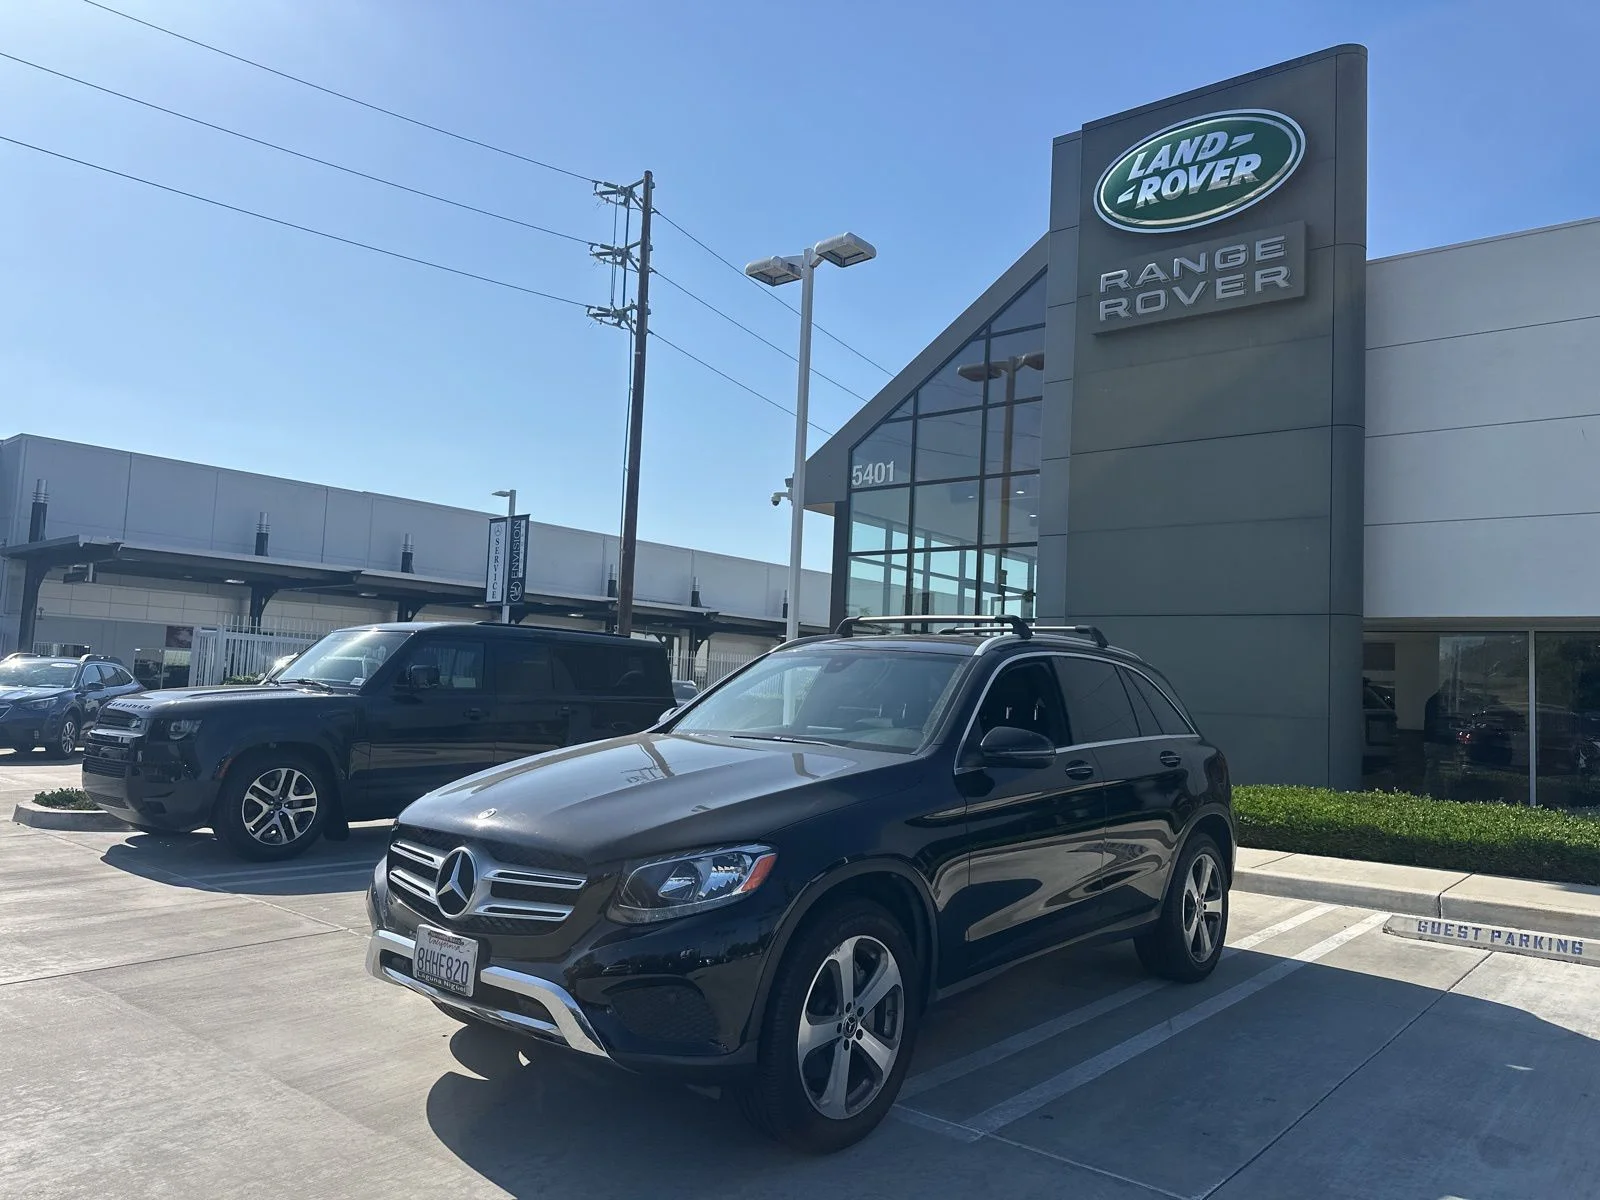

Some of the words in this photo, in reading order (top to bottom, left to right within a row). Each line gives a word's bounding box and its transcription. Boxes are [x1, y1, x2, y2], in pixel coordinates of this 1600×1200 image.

[1127, 131, 1228, 181] LAND
[1135, 153, 1262, 209] ROVER
[1100, 235, 1286, 293] RANGE
[1100, 265, 1292, 321] ROVER
[852, 460, 894, 486] 5401
[491, 537, 500, 599] SERVICE
[511, 520, 521, 579] ENVISION
[1417, 920, 1482, 940] GUEST
[1490, 929, 1584, 955] PARKING
[417, 947, 469, 985] 8HHF820
